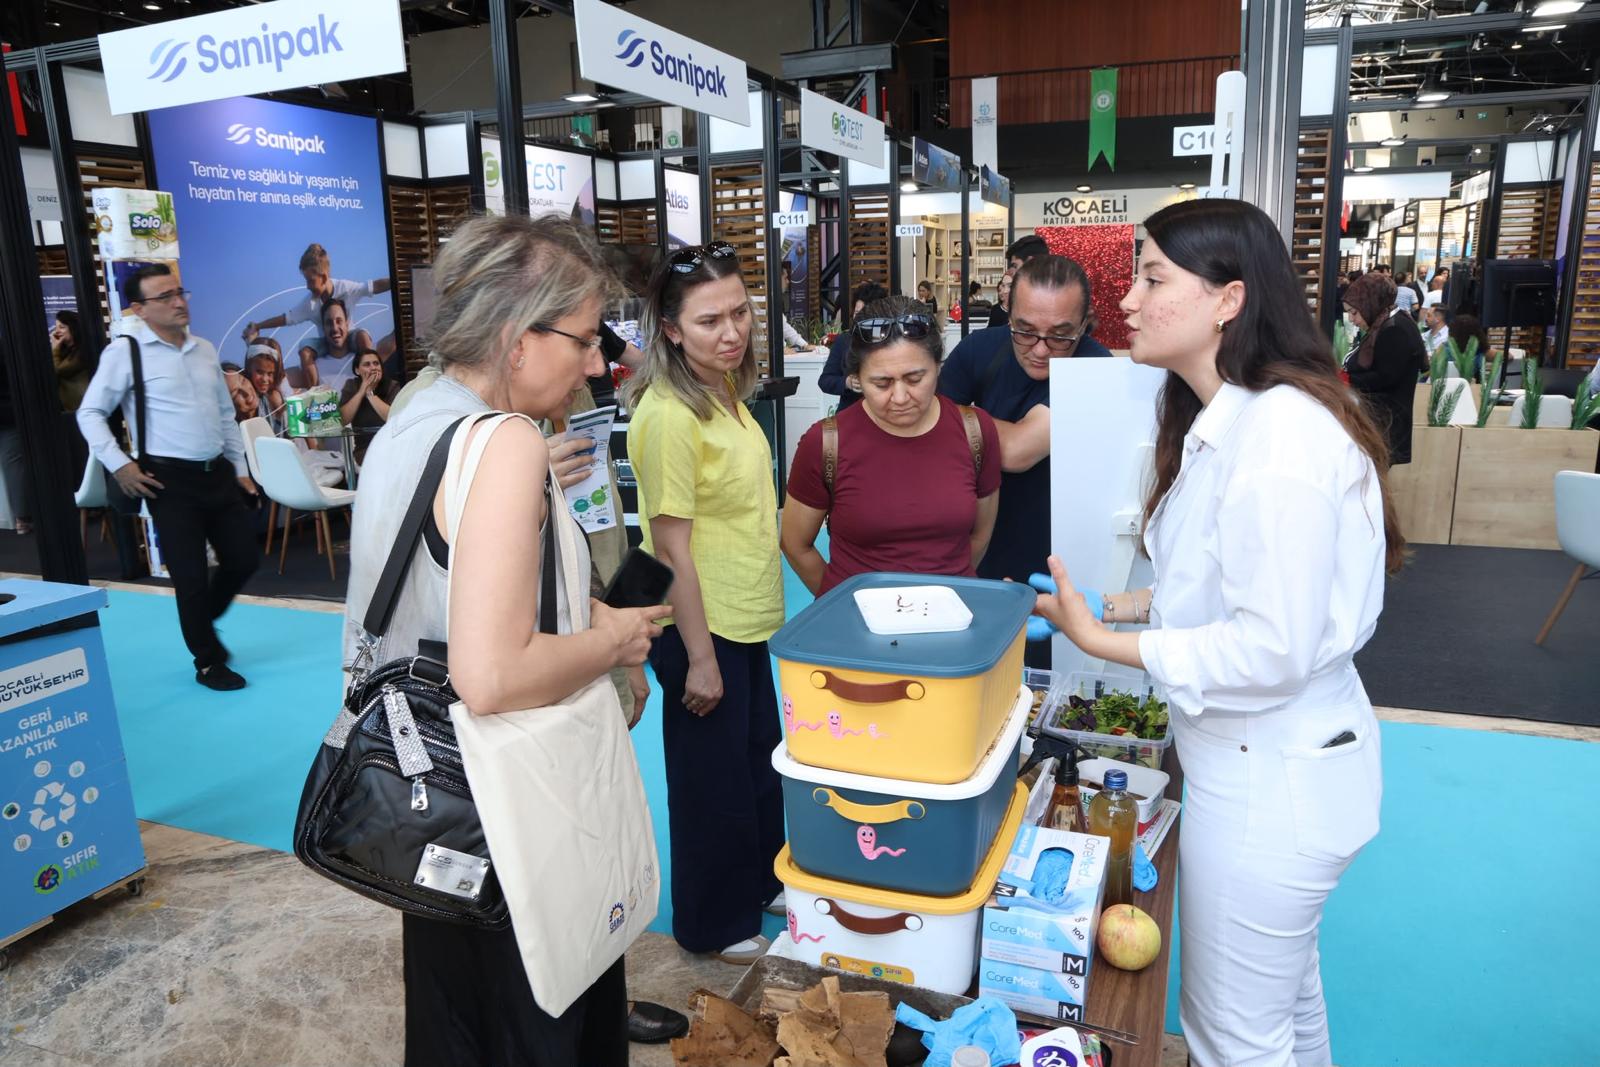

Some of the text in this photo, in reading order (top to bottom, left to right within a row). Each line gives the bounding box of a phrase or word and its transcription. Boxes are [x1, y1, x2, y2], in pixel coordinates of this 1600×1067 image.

[196, 14, 343, 73] Sanipak
[650, 40, 727, 97] Sanipak
[255, 127, 326, 155] Sanipak
[189, 160, 359, 192] Temiz ve sağlıklı bir yaşam için
[188, 183, 363, 211] hayatın her anına eşlik ediyoruz.
[1043, 195, 1127, 217] KOCAELİ
[132, 215, 160, 228] Solo
[778, 214, 804, 225] C111
[1043, 216, 1076, 225] HATIRA
[900, 226, 921, 235] C110
[320, 403, 337, 413] Solo
[0, 672, 44, 693] OCAELİ
[18, 706, 52, 730] GERİ
[0, 711, 88, 753] ZANILABİLİR
[25, 737, 58, 759] ATIK
[63, 844, 98, 869] SIFIR
[996, 881, 1014, 897] M
[989, 921, 1042, 938] CoreMed
[1072, 927, 1085, 941] 100
[1066, 957, 1084, 973] M
[986, 970, 1039, 988] CoreMed
[1067, 976, 1080, 990] 100
[1062, 1005, 1079, 1021] M
